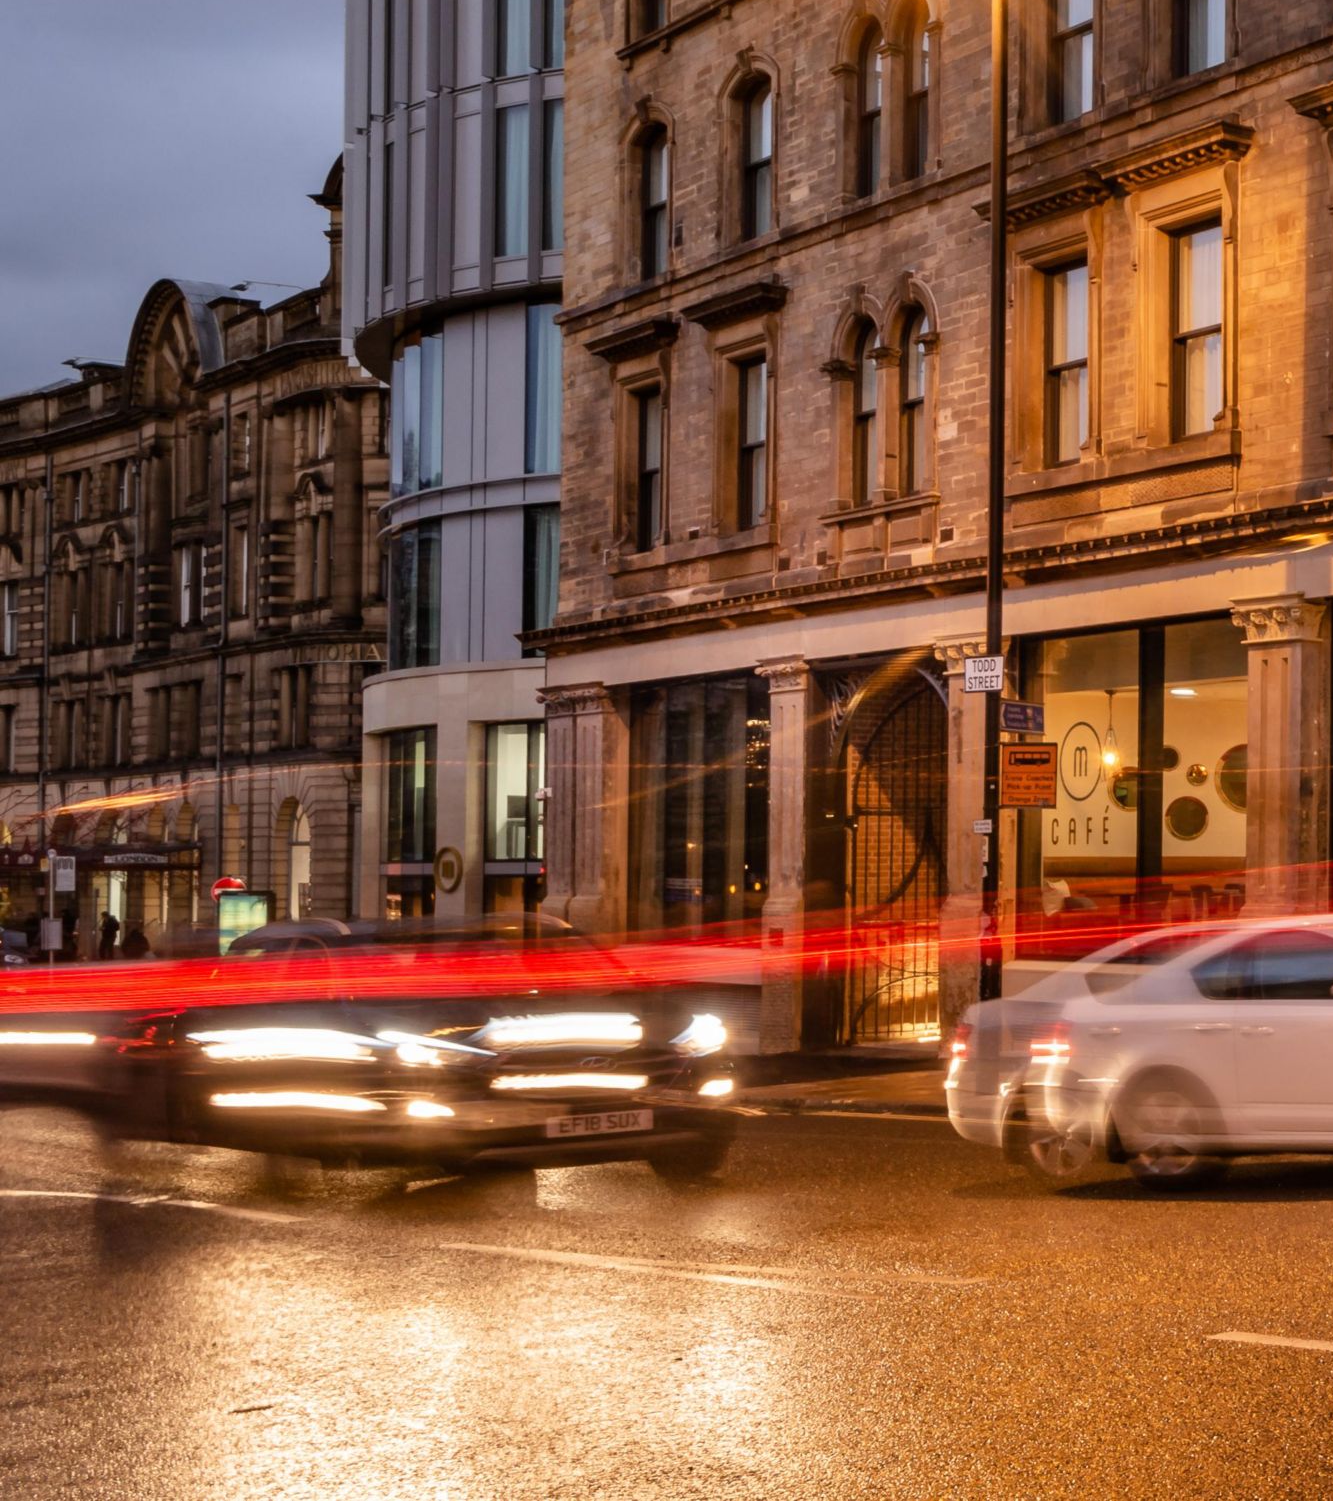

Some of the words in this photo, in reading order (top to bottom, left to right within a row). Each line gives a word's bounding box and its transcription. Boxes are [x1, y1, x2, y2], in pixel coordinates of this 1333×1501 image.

[972, 659, 997, 673] TODD
[968, 675, 1001, 690] STREET
[1051, 805, 1109, 846] CAFÉ
